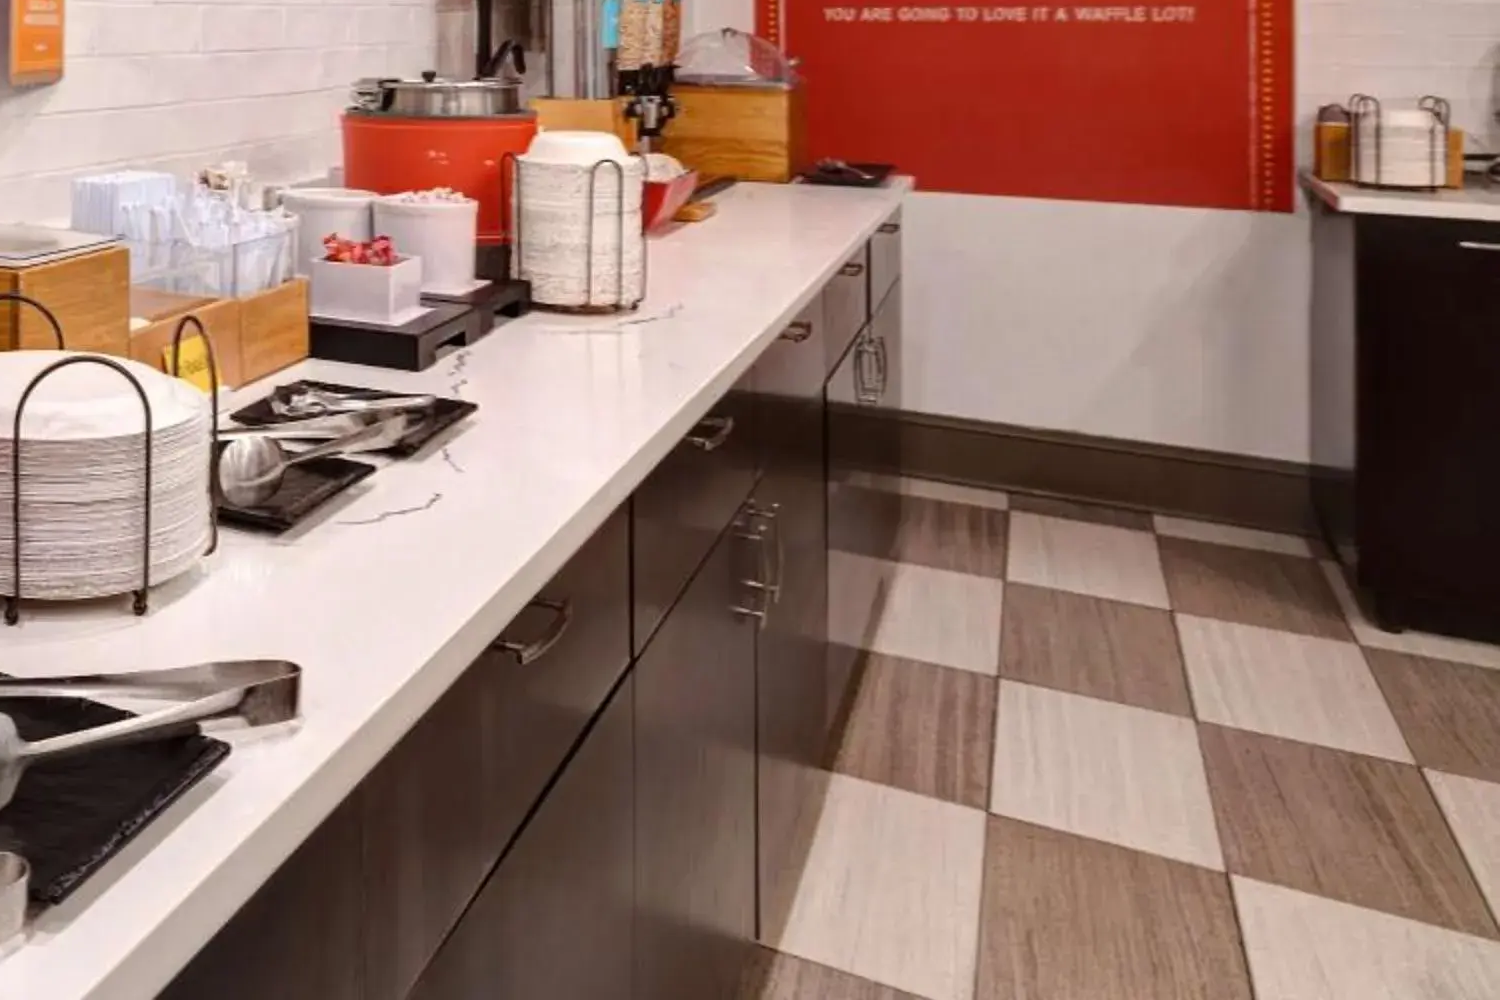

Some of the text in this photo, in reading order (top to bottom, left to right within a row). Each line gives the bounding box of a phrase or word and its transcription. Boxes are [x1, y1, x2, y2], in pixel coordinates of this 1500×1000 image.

[822, 6, 856, 22] YOU
[860, 6, 893, 22] ARE
[897, 6, 951, 22] GOING
[956, 6, 978, 22] TO
[982, 6, 1027, 22] LOVE
[1032, 6, 1049, 22] IT
[1054, 6, 1068, 22] A
[1074, 6, 1147, 22] WAFFLE
